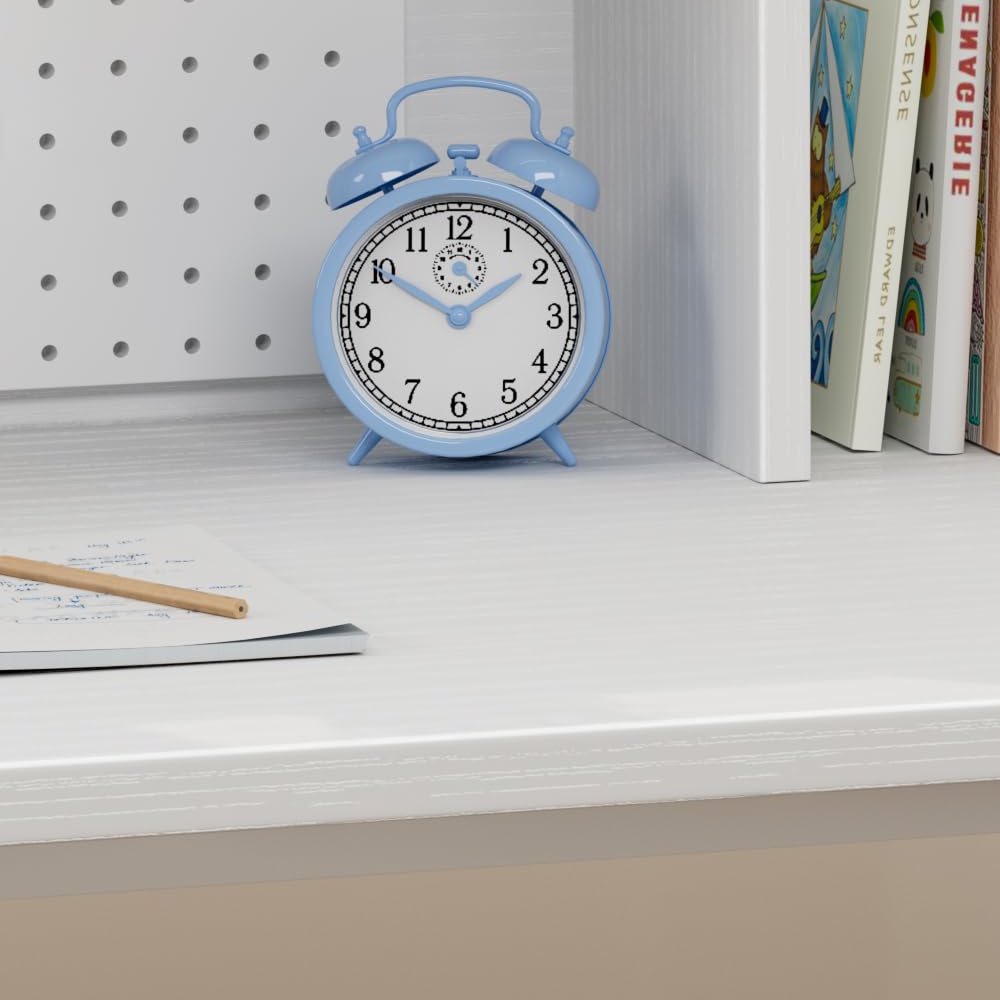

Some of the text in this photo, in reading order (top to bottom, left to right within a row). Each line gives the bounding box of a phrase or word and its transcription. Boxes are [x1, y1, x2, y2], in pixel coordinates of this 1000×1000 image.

[406, 227, 429, 253] 11
[447, 215, 473, 240] 12
[503, 228, 513, 253] 1
[370, 258, 396, 285] 10
[532, 259, 549, 285] 2
[355, 303, 372, 329] 9
[547, 304, 563, 329] 3
[368, 347, 385, 373] 8
[532, 349, 549, 374] 4
[404, 379, 421, 405] 7
[451, 391, 467, 417] 6
[501, 379, 518, 405] 5
